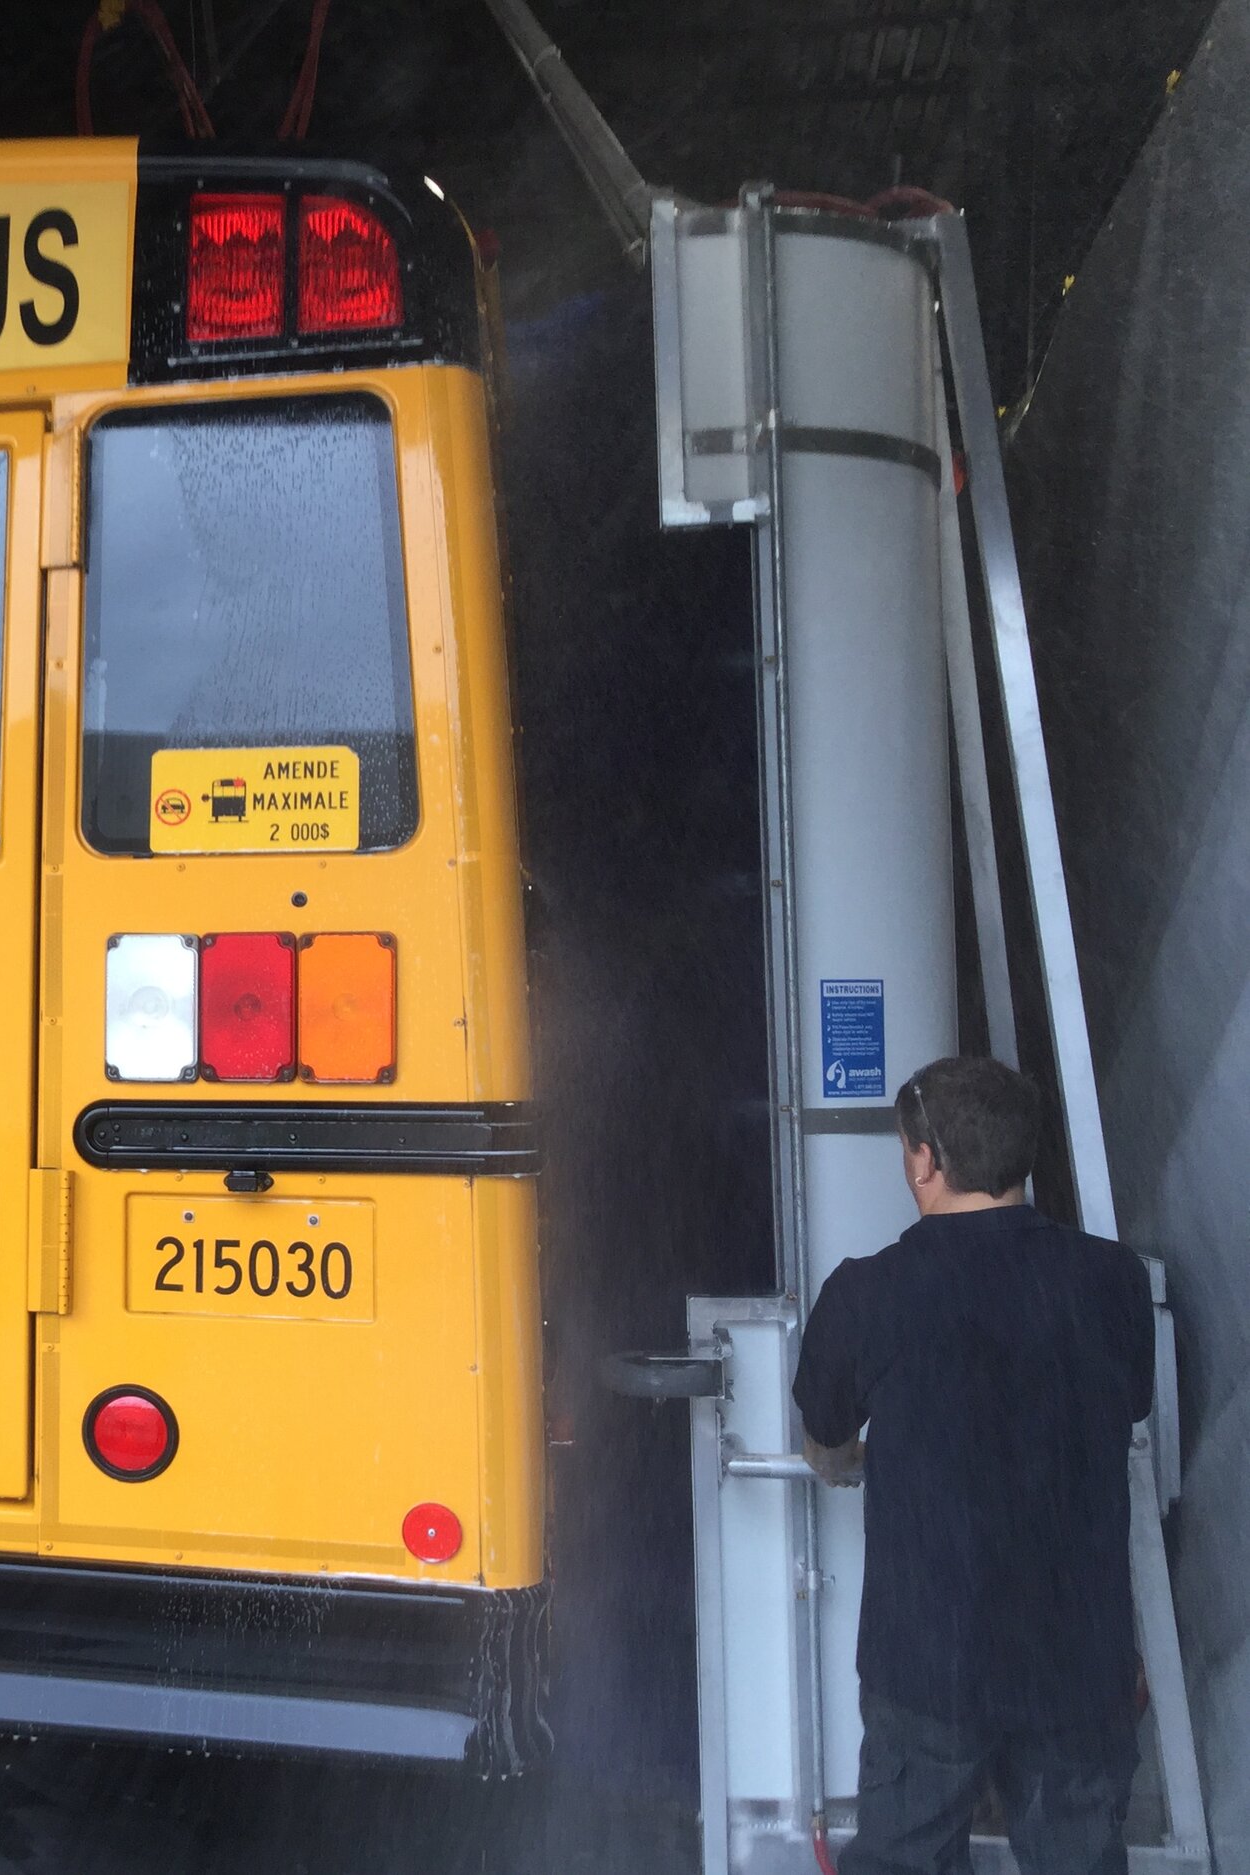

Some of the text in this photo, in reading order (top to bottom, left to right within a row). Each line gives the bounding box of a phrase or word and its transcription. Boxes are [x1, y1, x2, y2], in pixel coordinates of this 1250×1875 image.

[263, 760, 340, 780] AMENDE
[252, 791, 349, 810] MAXIMALE
[269, 822, 330, 841] 2 000$
[825, 985, 880, 994] INSTRUCTIONS
[848, 1067, 882, 1077] awash
[154, 1236, 352, 1299] 215030
